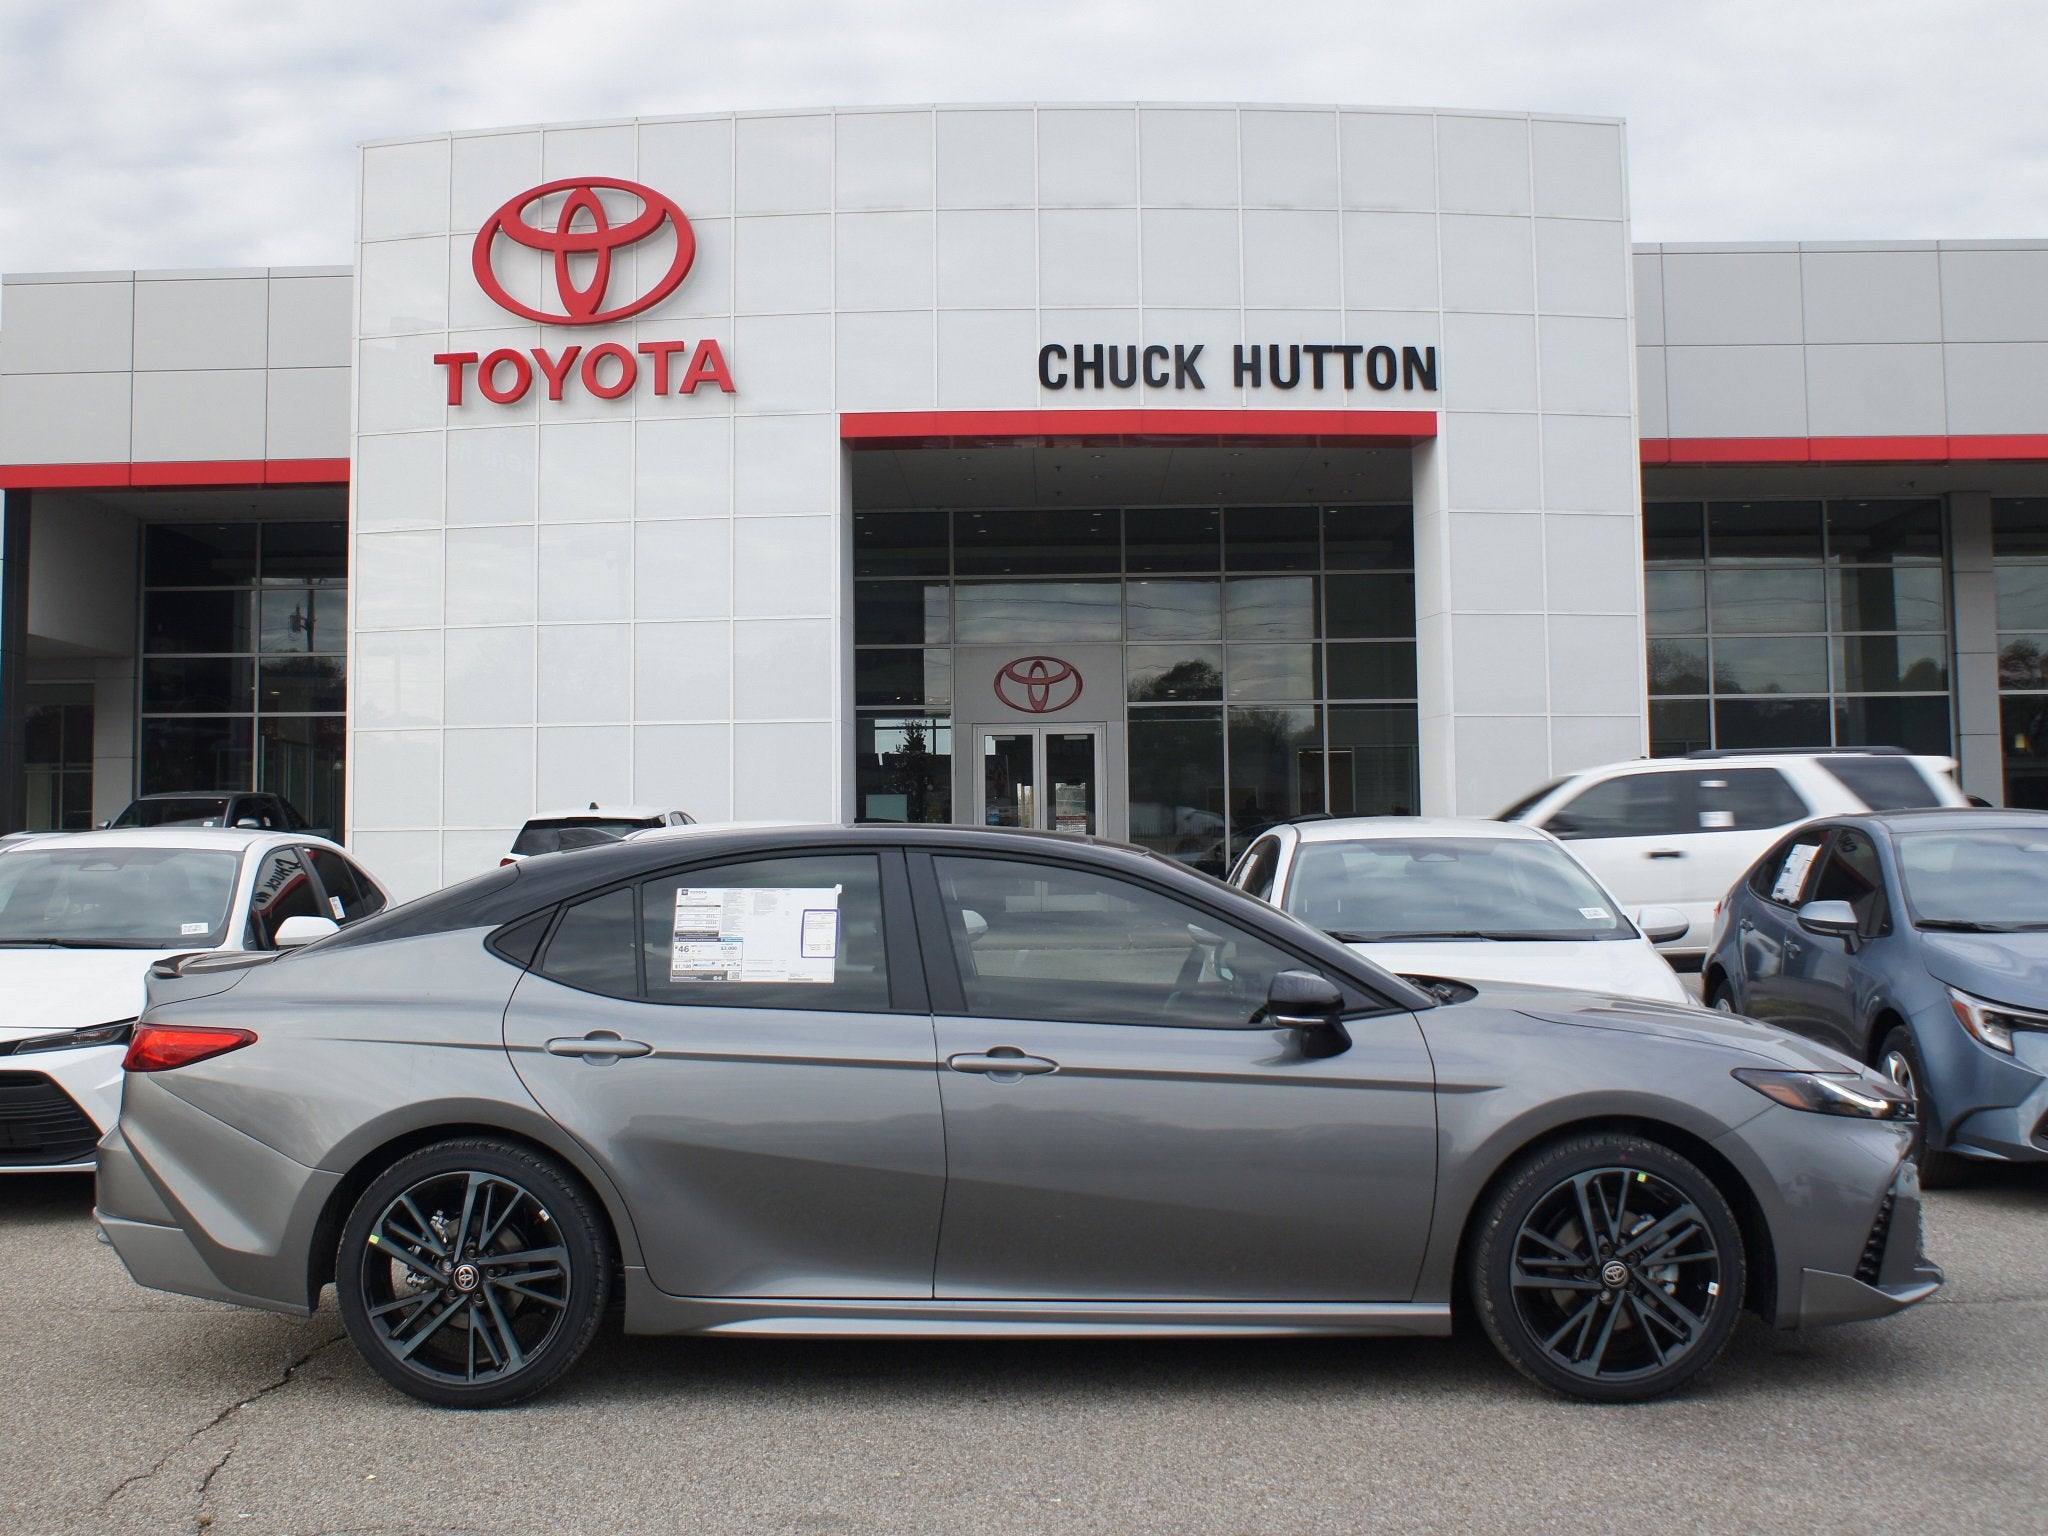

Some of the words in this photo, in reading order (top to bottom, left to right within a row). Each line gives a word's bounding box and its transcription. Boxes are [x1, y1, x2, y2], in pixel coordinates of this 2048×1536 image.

[434, 340, 735, 405] TOYOTA
[1039, 344, 1205, 390] CHUCK
[1234, 345, 1437, 391] HUTTON
